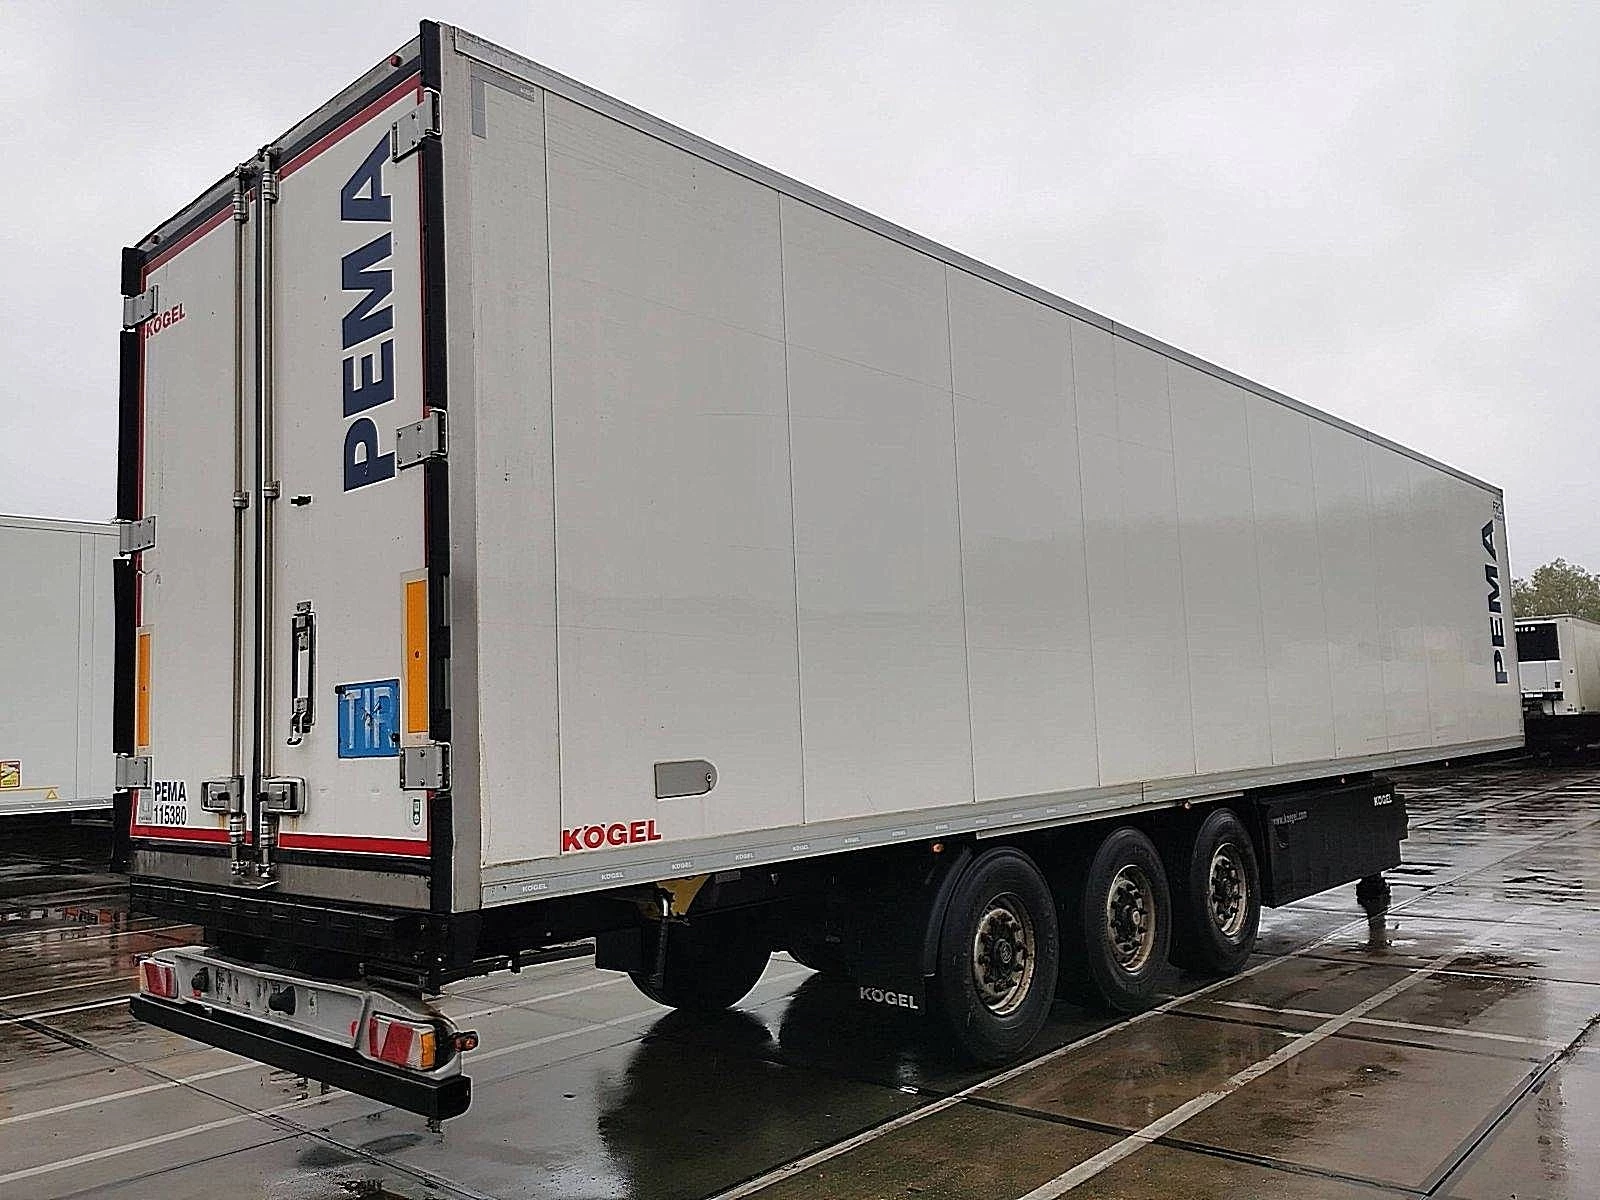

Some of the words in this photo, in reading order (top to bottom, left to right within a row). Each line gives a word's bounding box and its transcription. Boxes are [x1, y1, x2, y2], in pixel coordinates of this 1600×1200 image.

[340, 130, 396, 492] PEMA
[1481, 520, 1508, 684] PEMA
[154, 781, 187, 802] PEMA
[154, 804, 187, 825] 115380
[562, 820, 662, 851] KÖGEL
[860, 986, 919, 1010] KÖGEL
